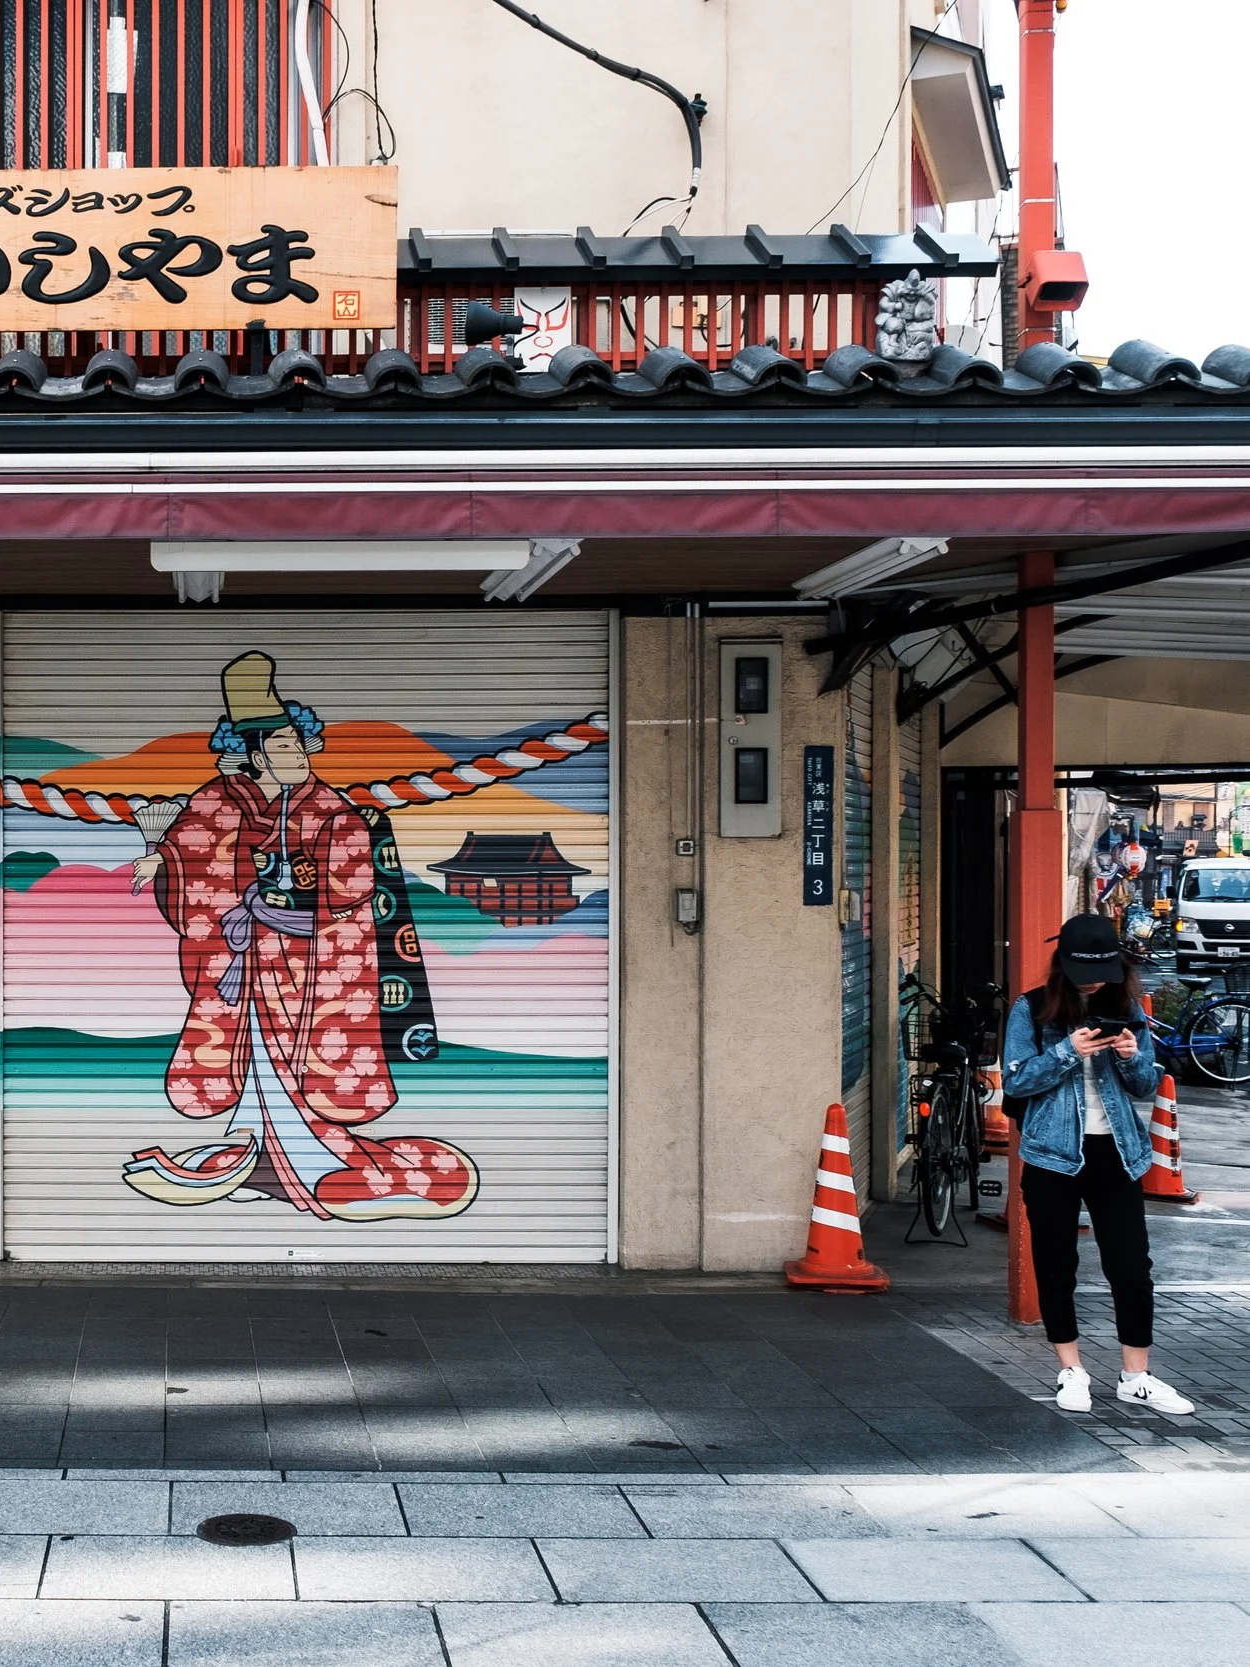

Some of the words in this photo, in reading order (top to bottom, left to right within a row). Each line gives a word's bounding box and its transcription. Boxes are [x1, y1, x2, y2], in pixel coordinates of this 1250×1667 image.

[336, 293, 358, 318] 石山
[811, 782, 826, 866] 浅草二丁目
[812, 879, 823, 895] 3
